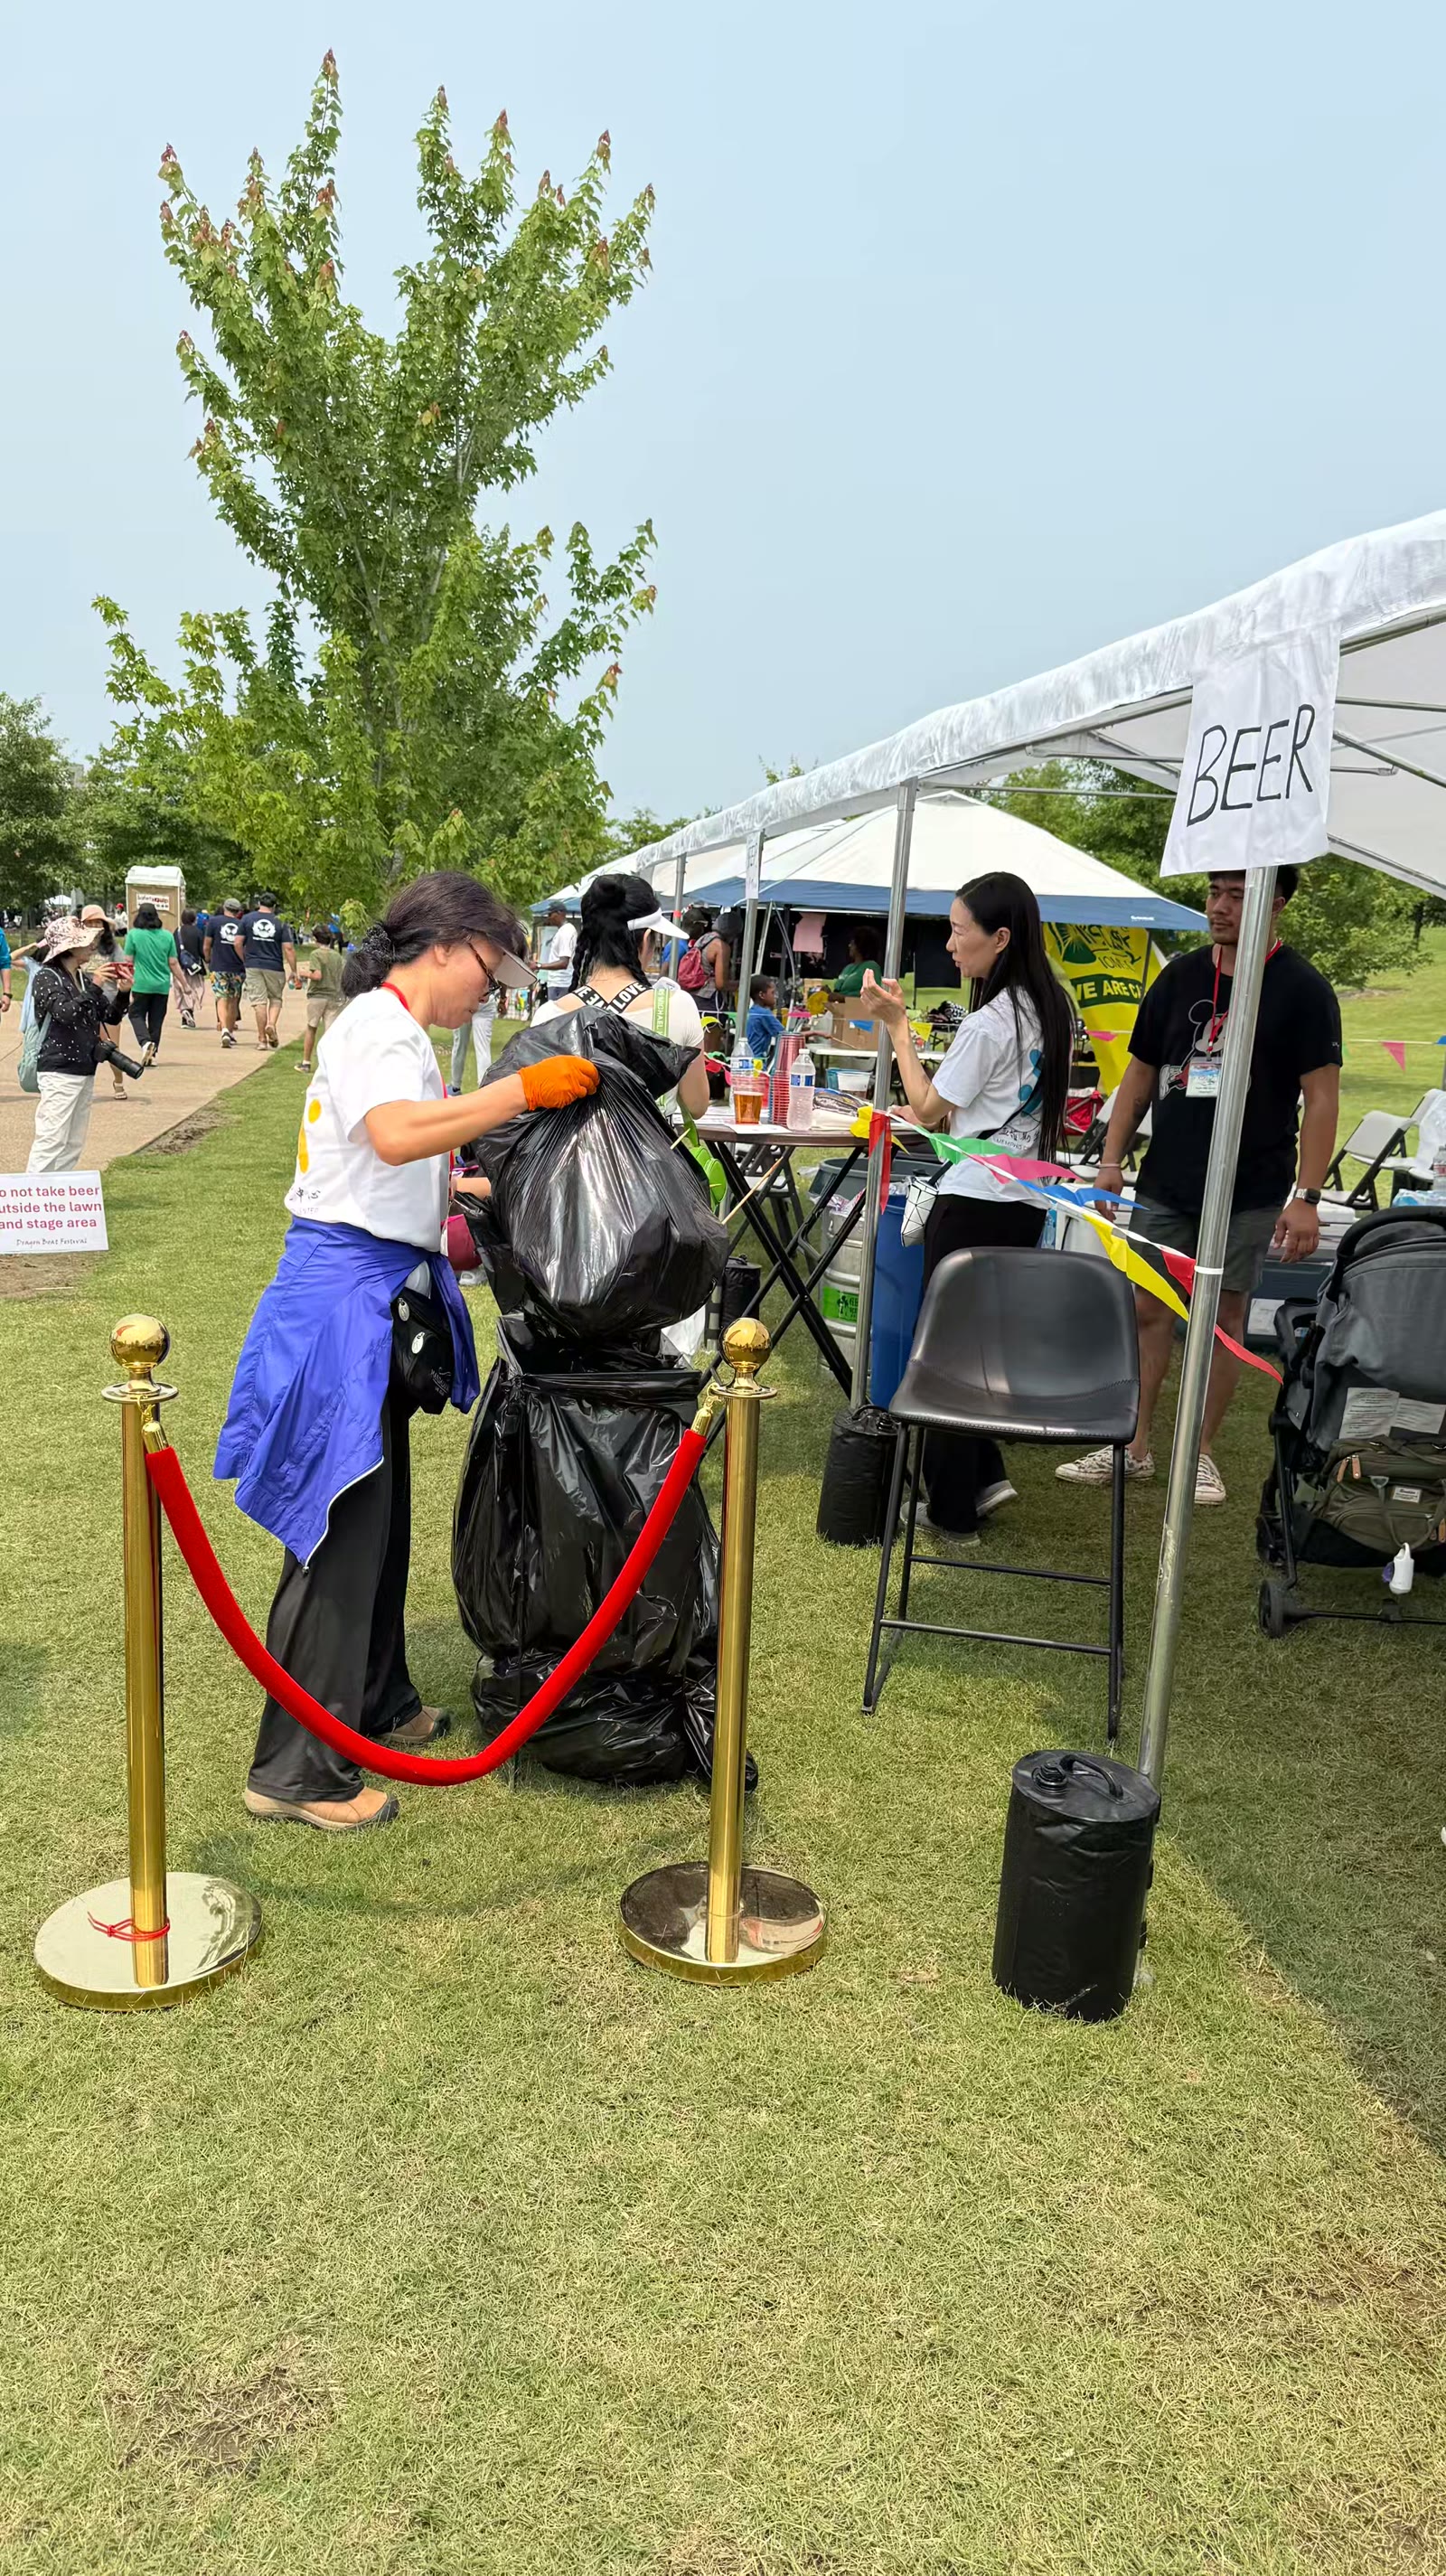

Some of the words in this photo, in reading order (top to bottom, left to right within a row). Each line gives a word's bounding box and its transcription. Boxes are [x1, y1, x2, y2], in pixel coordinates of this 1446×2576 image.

[1186, 703, 1316, 828] BEER
[615, 981, 647, 1010] LOVE
[1103, 980, 1130, 997] ARE
[656, 996, 665, 1029] MICHAEL
[10, 1187, 33, 1198] not
[36, 1186, 66, 1197] take
[69, 1185, 100, 1196] beer
[43, 1202, 66, 1212] the
[70, 1201, 102, 1212] lawn
[0, 1218, 23, 1229] and
[26, 1218, 63, 1231] stage
[67, 1218, 97, 1227] area
[16, 1238, 41, 1248] Dragon
